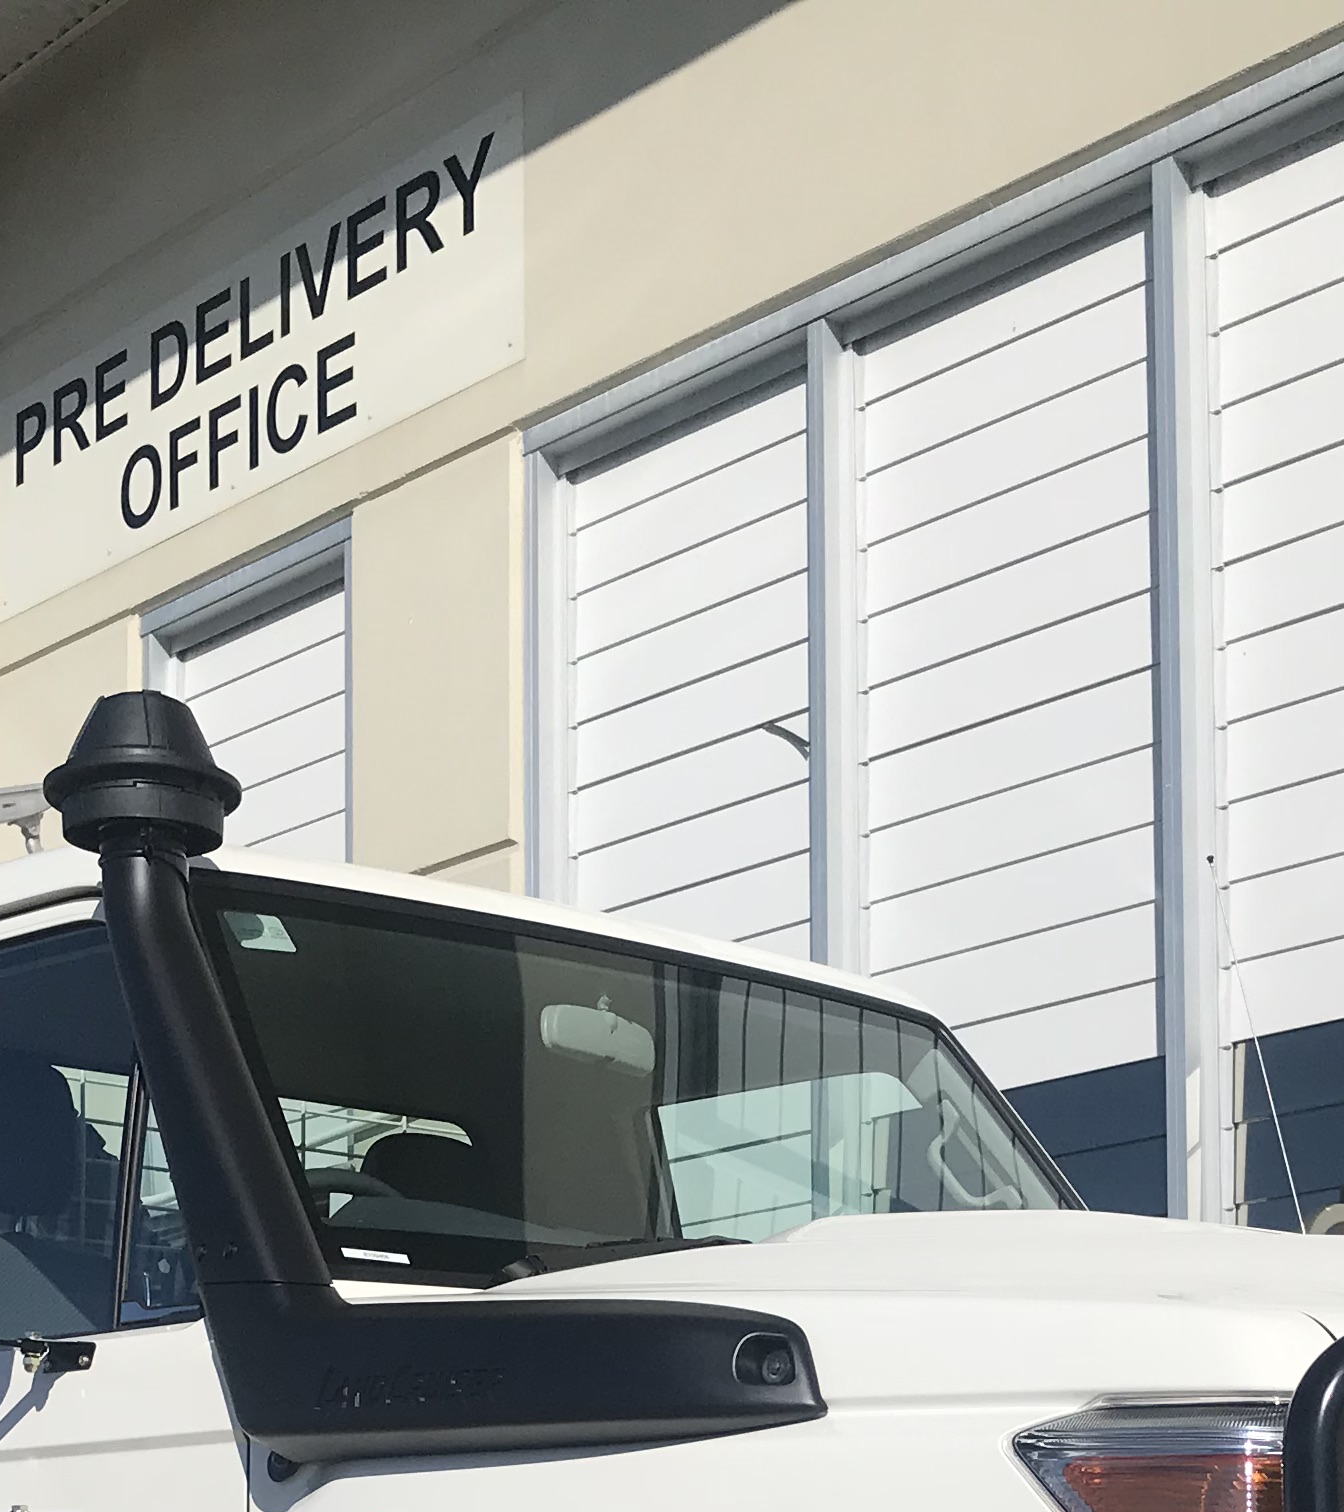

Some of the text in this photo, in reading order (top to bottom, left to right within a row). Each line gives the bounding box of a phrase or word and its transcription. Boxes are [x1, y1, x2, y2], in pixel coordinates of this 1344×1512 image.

[15, 131, 496, 488] PRE DELIVERY
[120, 331, 358, 530] OFFICE
